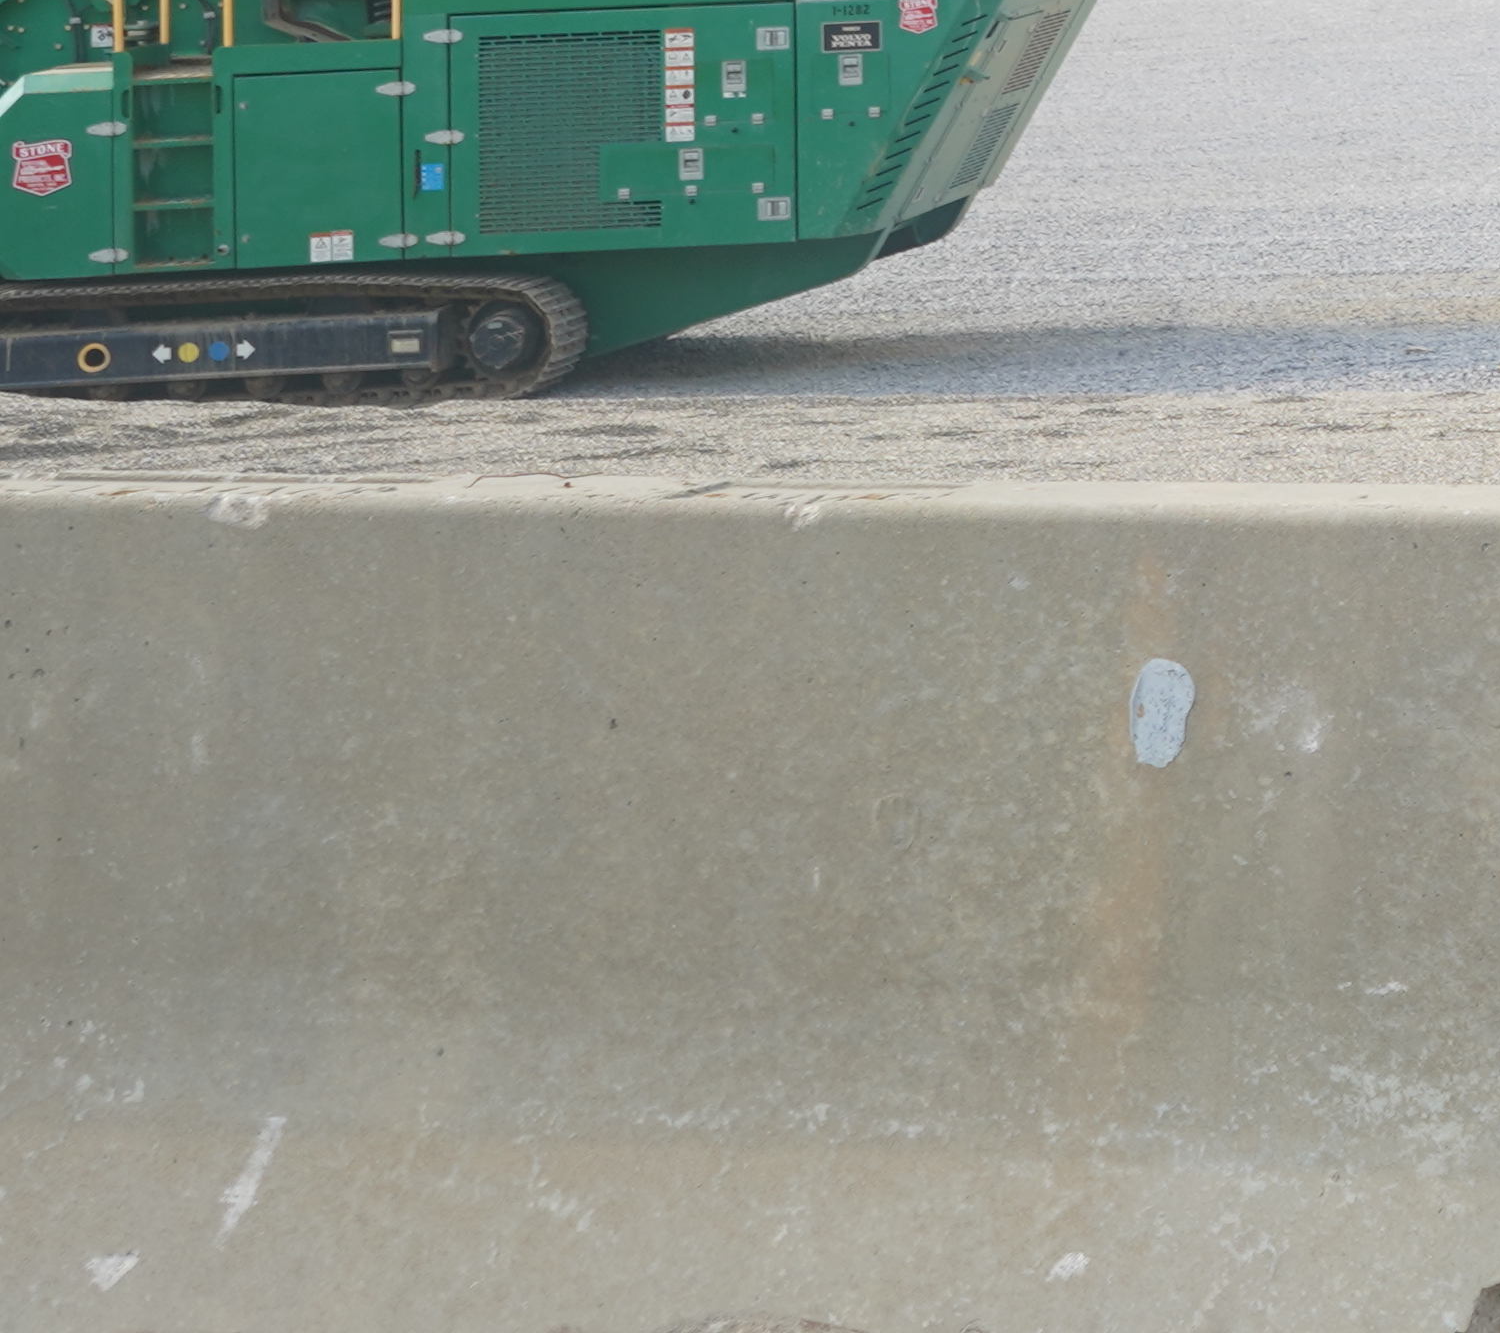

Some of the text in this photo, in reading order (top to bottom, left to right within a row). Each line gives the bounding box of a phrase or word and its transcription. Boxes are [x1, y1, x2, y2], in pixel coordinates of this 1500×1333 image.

[830, 33, 872, 42] VOLVO
[831, 39, 872, 48] PENTA
[19, 143, 65, 158] STONE
